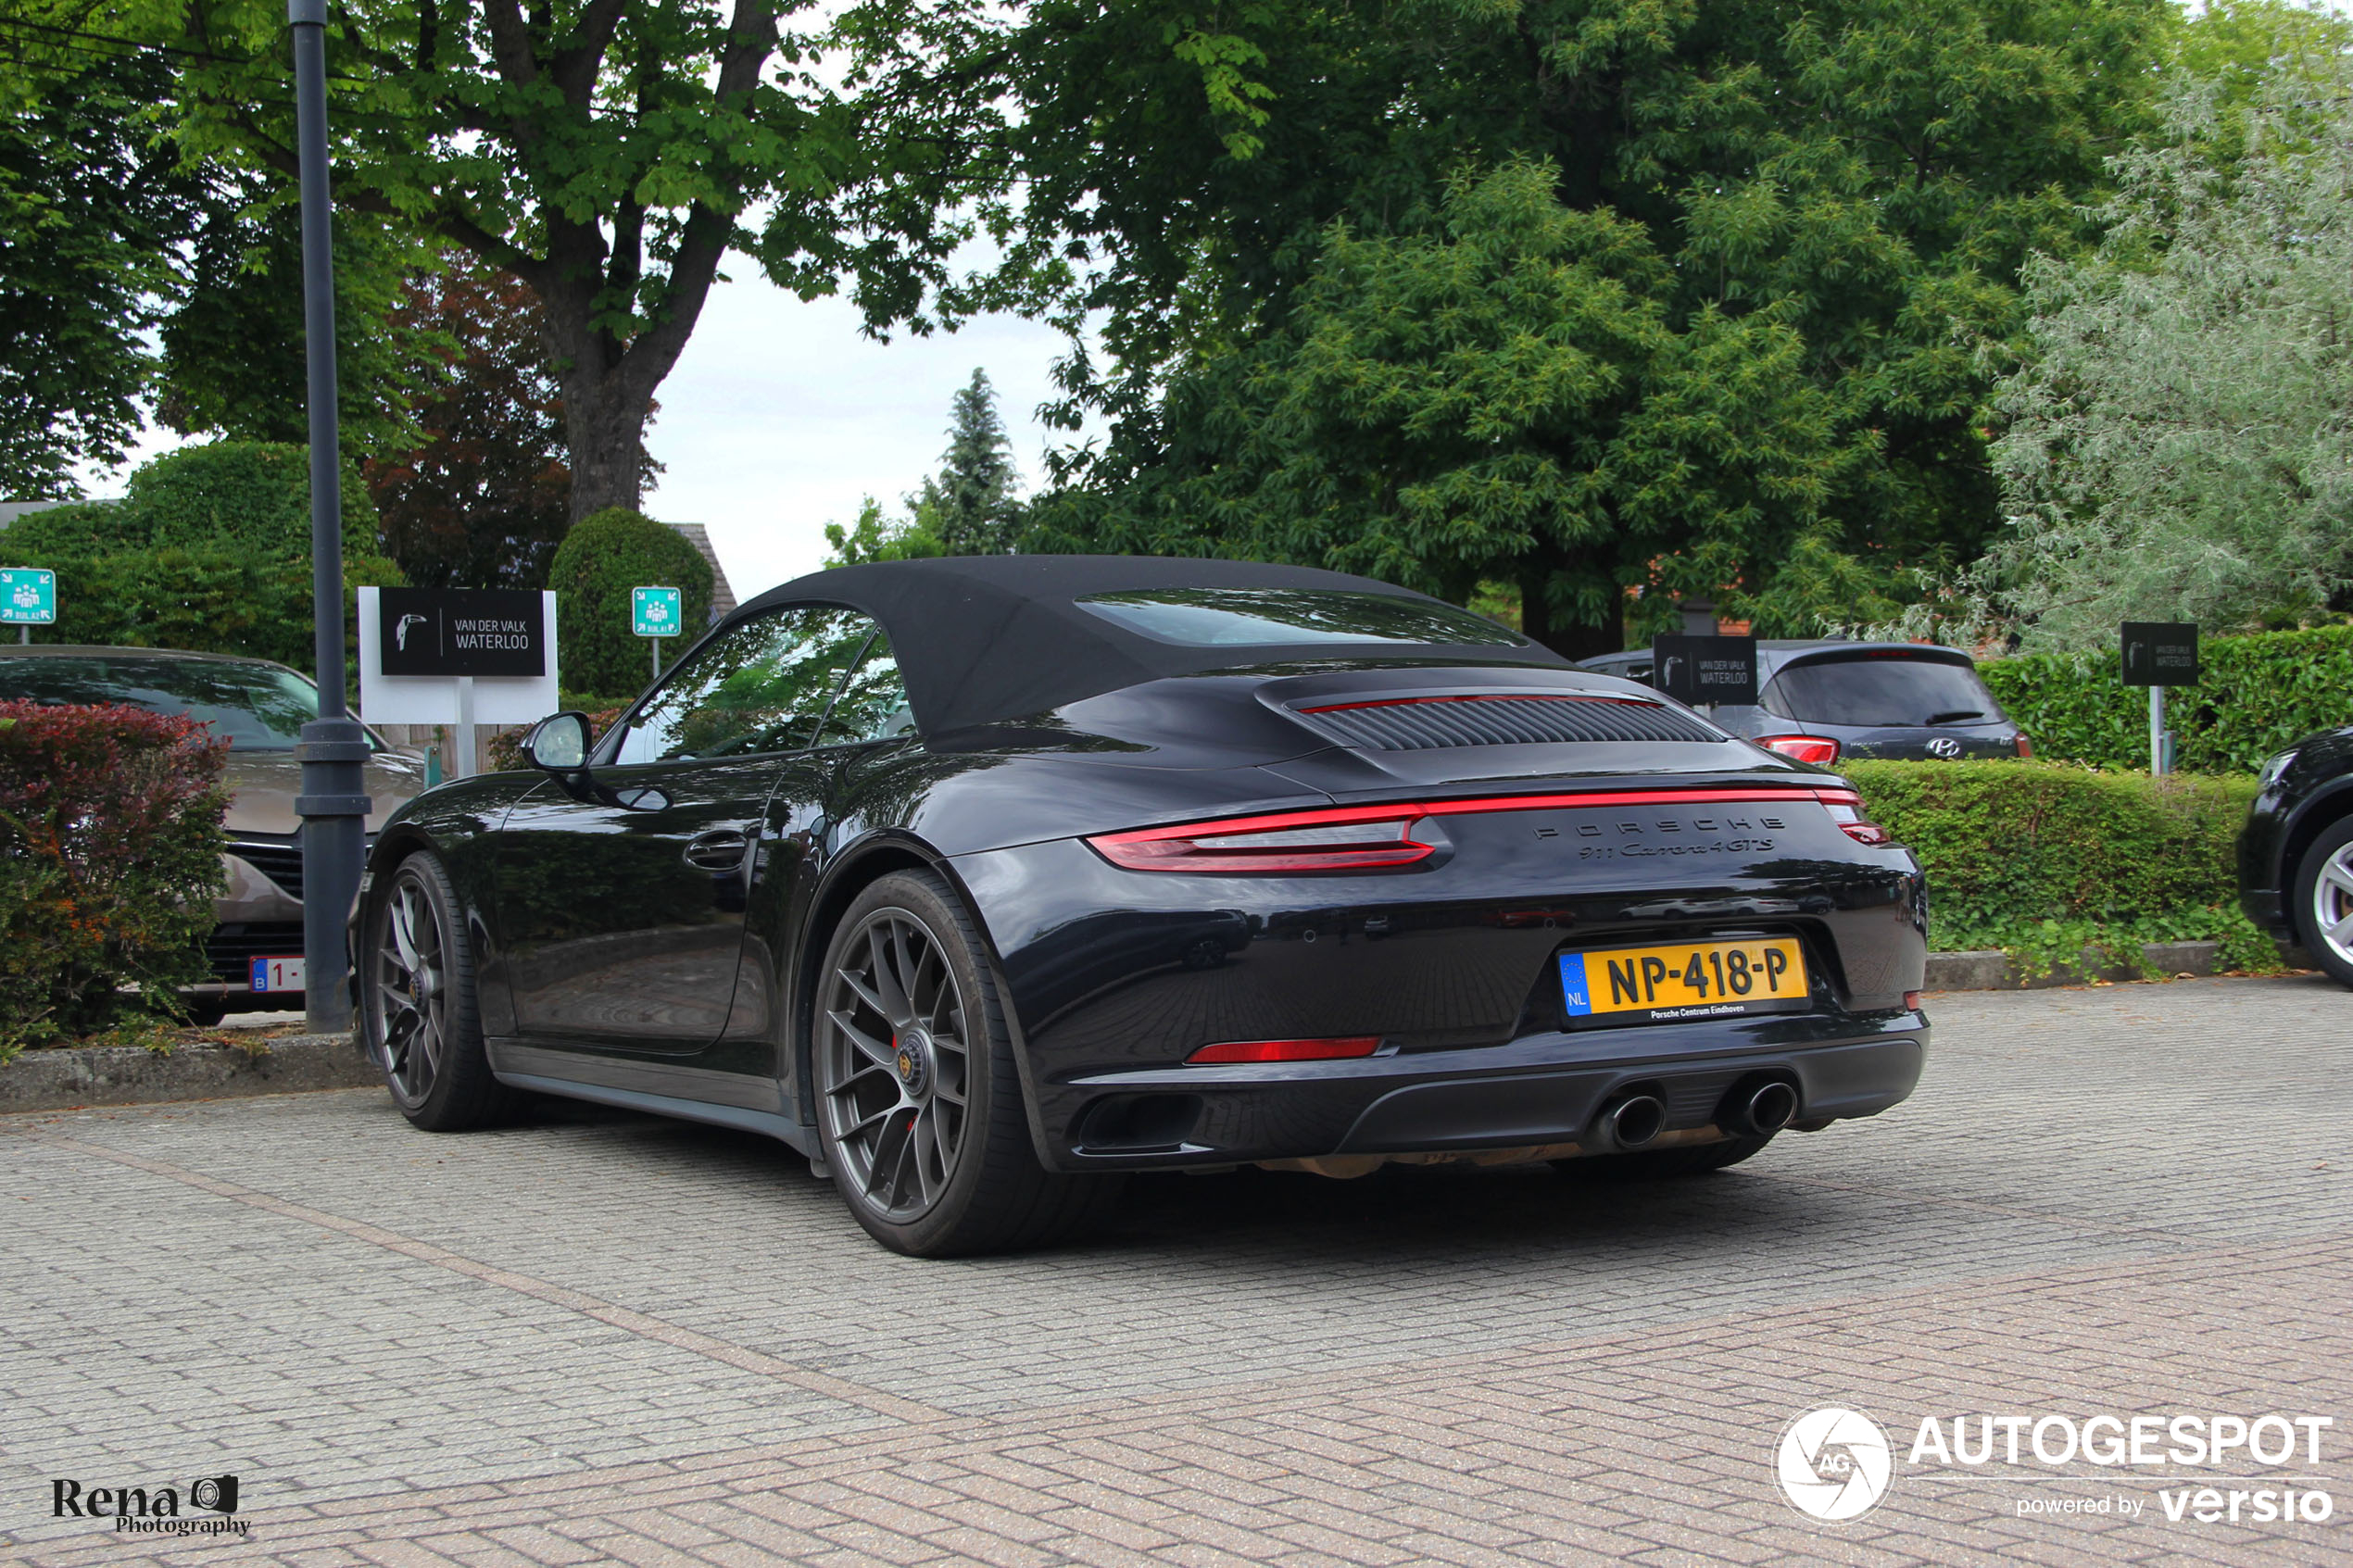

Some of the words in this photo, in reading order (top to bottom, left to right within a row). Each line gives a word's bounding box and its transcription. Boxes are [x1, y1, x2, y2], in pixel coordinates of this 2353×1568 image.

[455, 619, 476, 632] VAN
[478, 620, 499, 632] DER
[500, 620, 527, 633] VALK
[456, 633, 529, 649] WATERLOO
[1698, 660, 1714, 670] VAN
[1714, 660, 1728, 670] DER
[1729, 660, 1747, 670] VALK
[1700, 672, 1748, 684] WATERLOO
[1533, 818, 1786, 840] PORSCHE
[255, 977, 266, 989] B
[1607, 947, 1788, 1005] NP-418-P
[1567, 992, 1587, 1007] NL
[1651, 1010, 1680, 1019] Porsche
[1680, 1008, 1710, 1017] Centrum
[1710, 1004, 1744, 1014] Eindhoven
